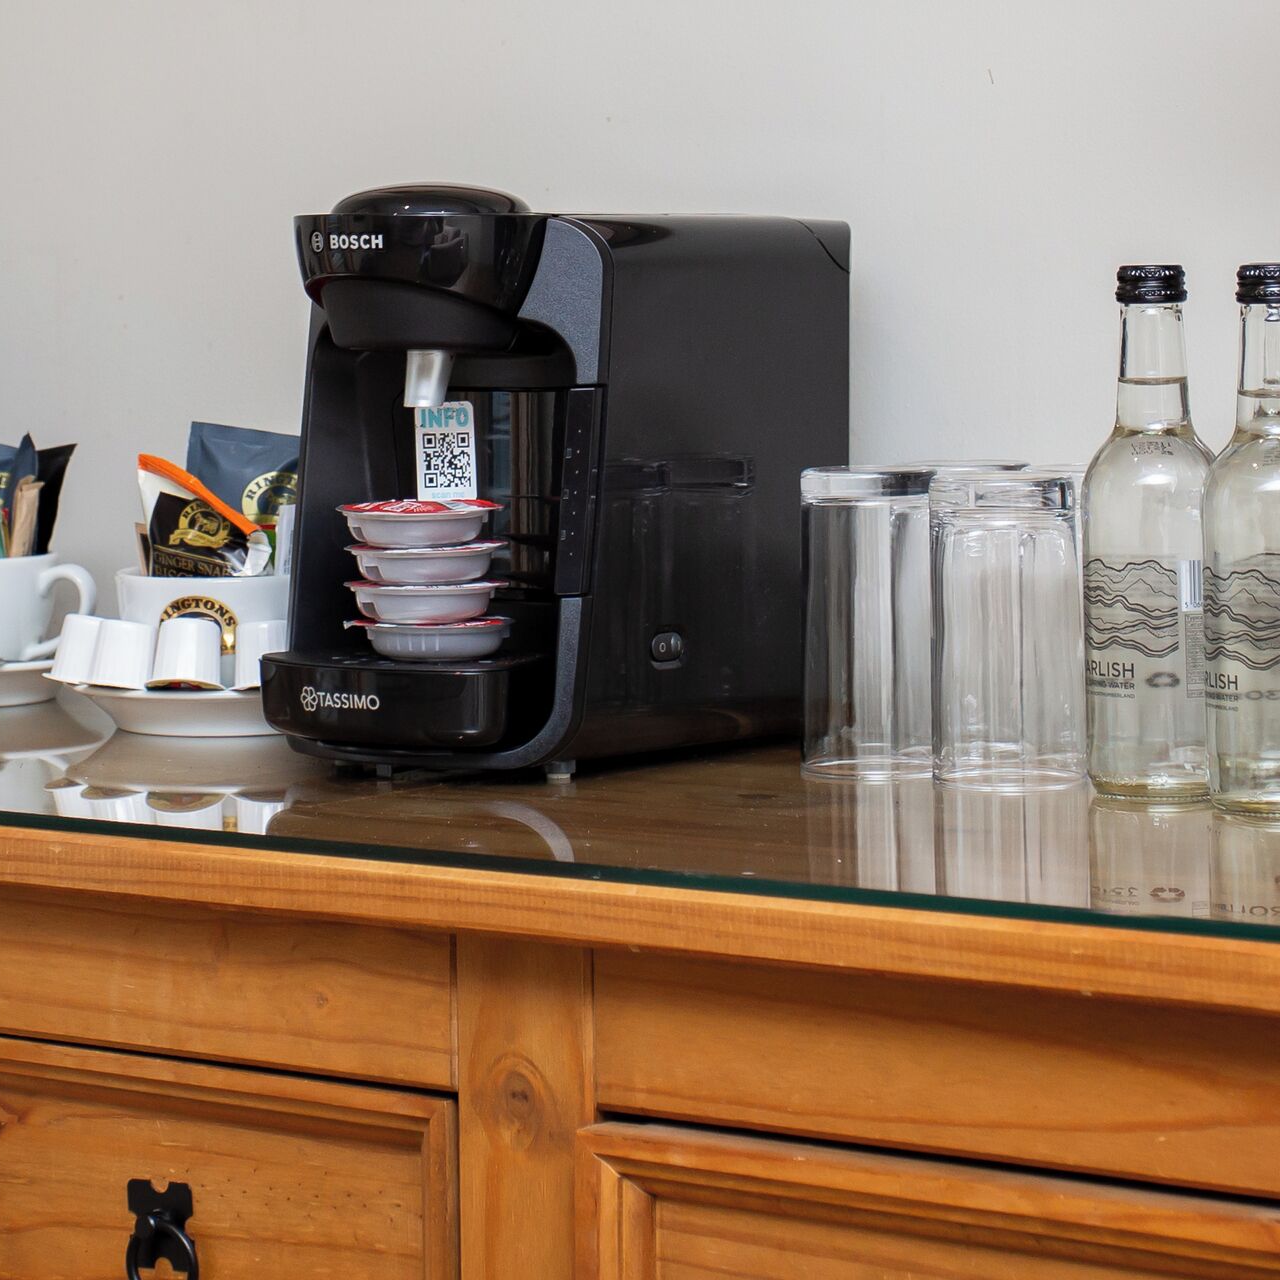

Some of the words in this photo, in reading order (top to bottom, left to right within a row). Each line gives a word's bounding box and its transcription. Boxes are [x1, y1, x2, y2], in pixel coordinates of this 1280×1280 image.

[329, 234, 383, 249] BOSCH
[420, 406, 469, 428] INFO
[160, 598, 236, 627] INGTONS
[1108, 681, 1135, 690] WATER
[317, 691, 380, 710] TASSIMO
